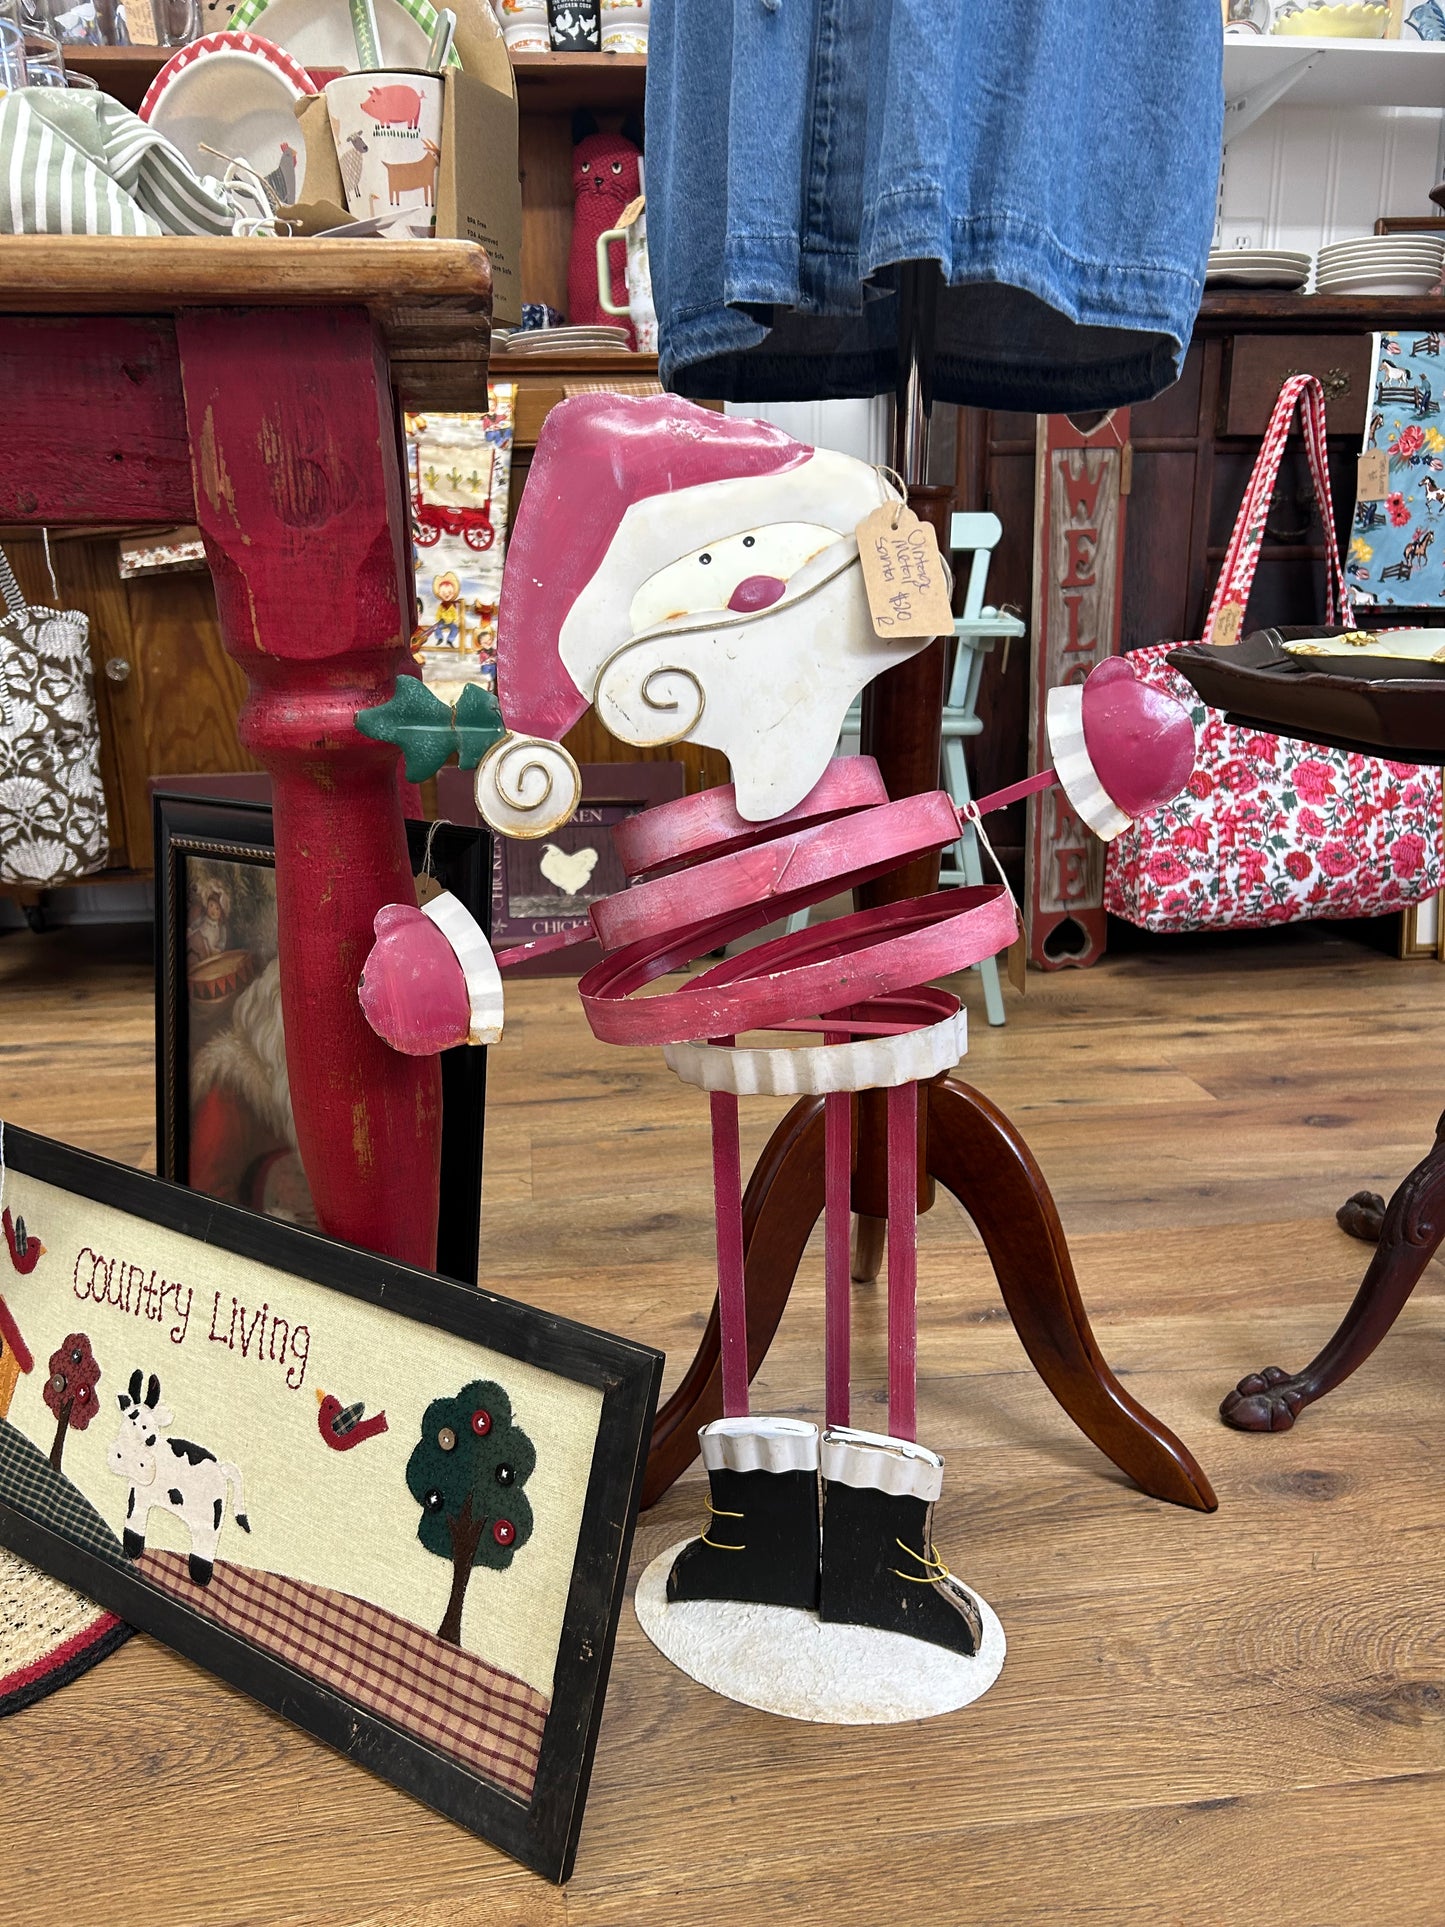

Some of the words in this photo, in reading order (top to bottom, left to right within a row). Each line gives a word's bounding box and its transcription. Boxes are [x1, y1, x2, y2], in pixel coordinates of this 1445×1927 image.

[478, 233, 499, 247] Approved
[891, 540, 915, 584] Metal
[889, 591, 912, 621] $20
[1052, 460, 1108, 900] WELME
[74, 1247, 194, 1344] Country
[208, 1290, 311, 1390] Living
